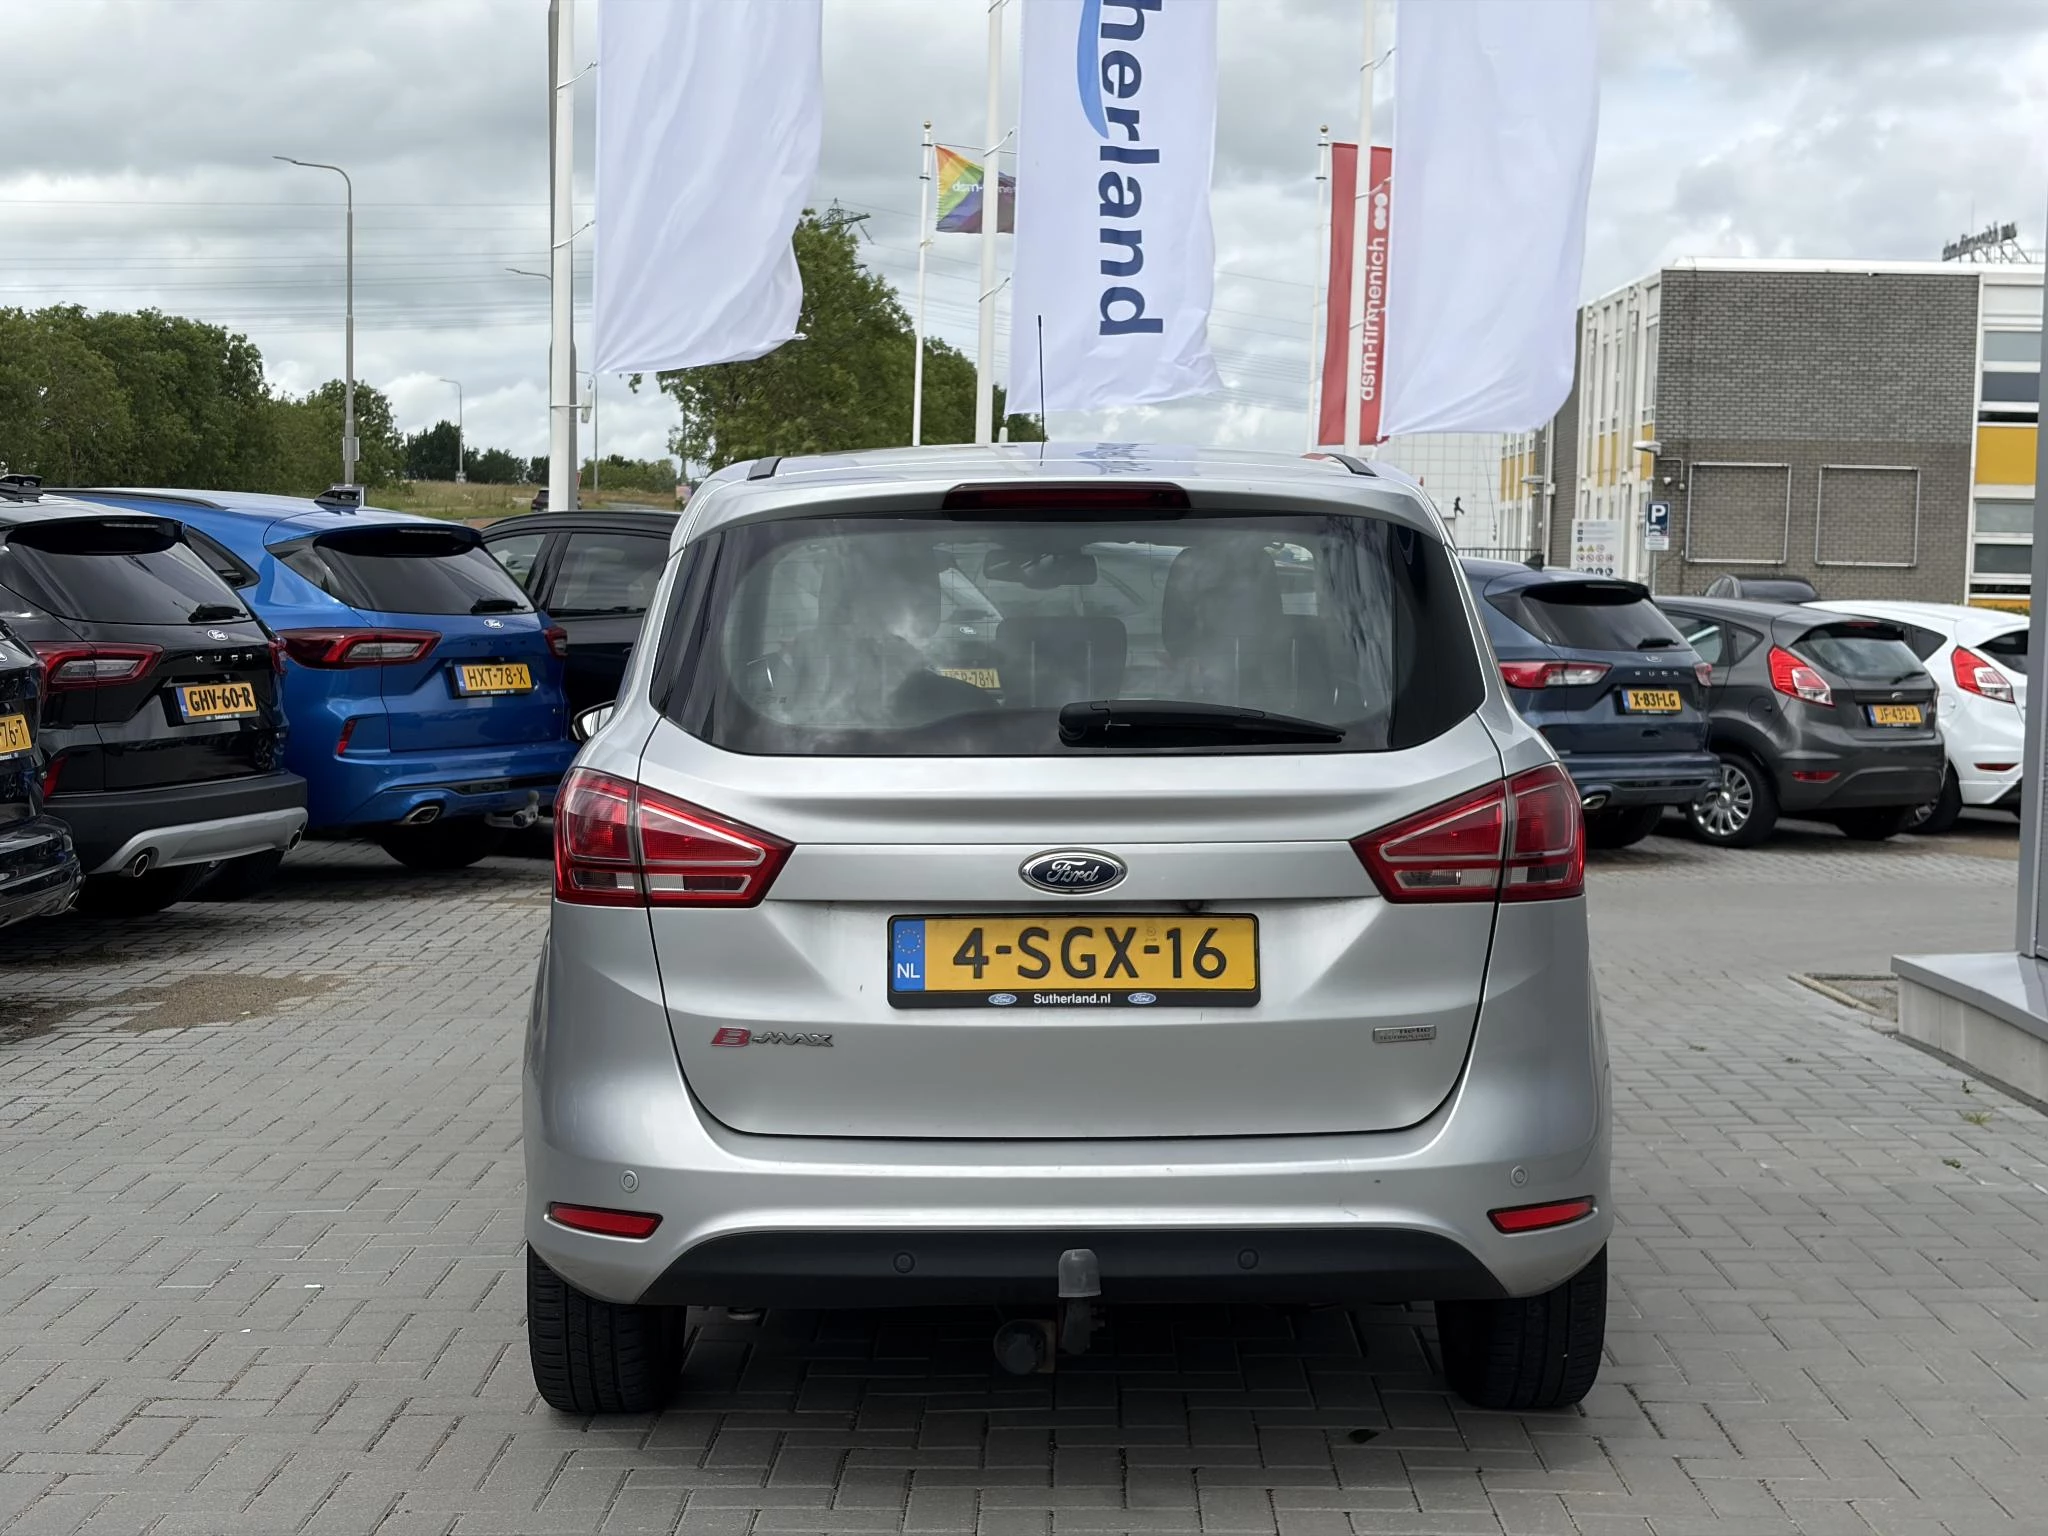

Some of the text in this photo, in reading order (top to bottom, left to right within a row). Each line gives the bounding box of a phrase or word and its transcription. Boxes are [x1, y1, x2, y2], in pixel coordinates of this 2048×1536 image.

[1361, 238, 1385, 401] dsm-firmenich
[1651, 505, 1666, 523] P
[467, 667, 527, 688] HXT-78-X
[189, 686, 253, 711] GHV-60-R
[1632, 692, 1676, 707] X-831-LG
[1046, 860, 1100, 883] Ford
[953, 926, 1227, 980] 4-SGX-16
[896, 963, 921, 979] NL
[1033, 993, 1112, 1005] Sutherland.nl
[711, 1026, 834, 1047] B-MAX
